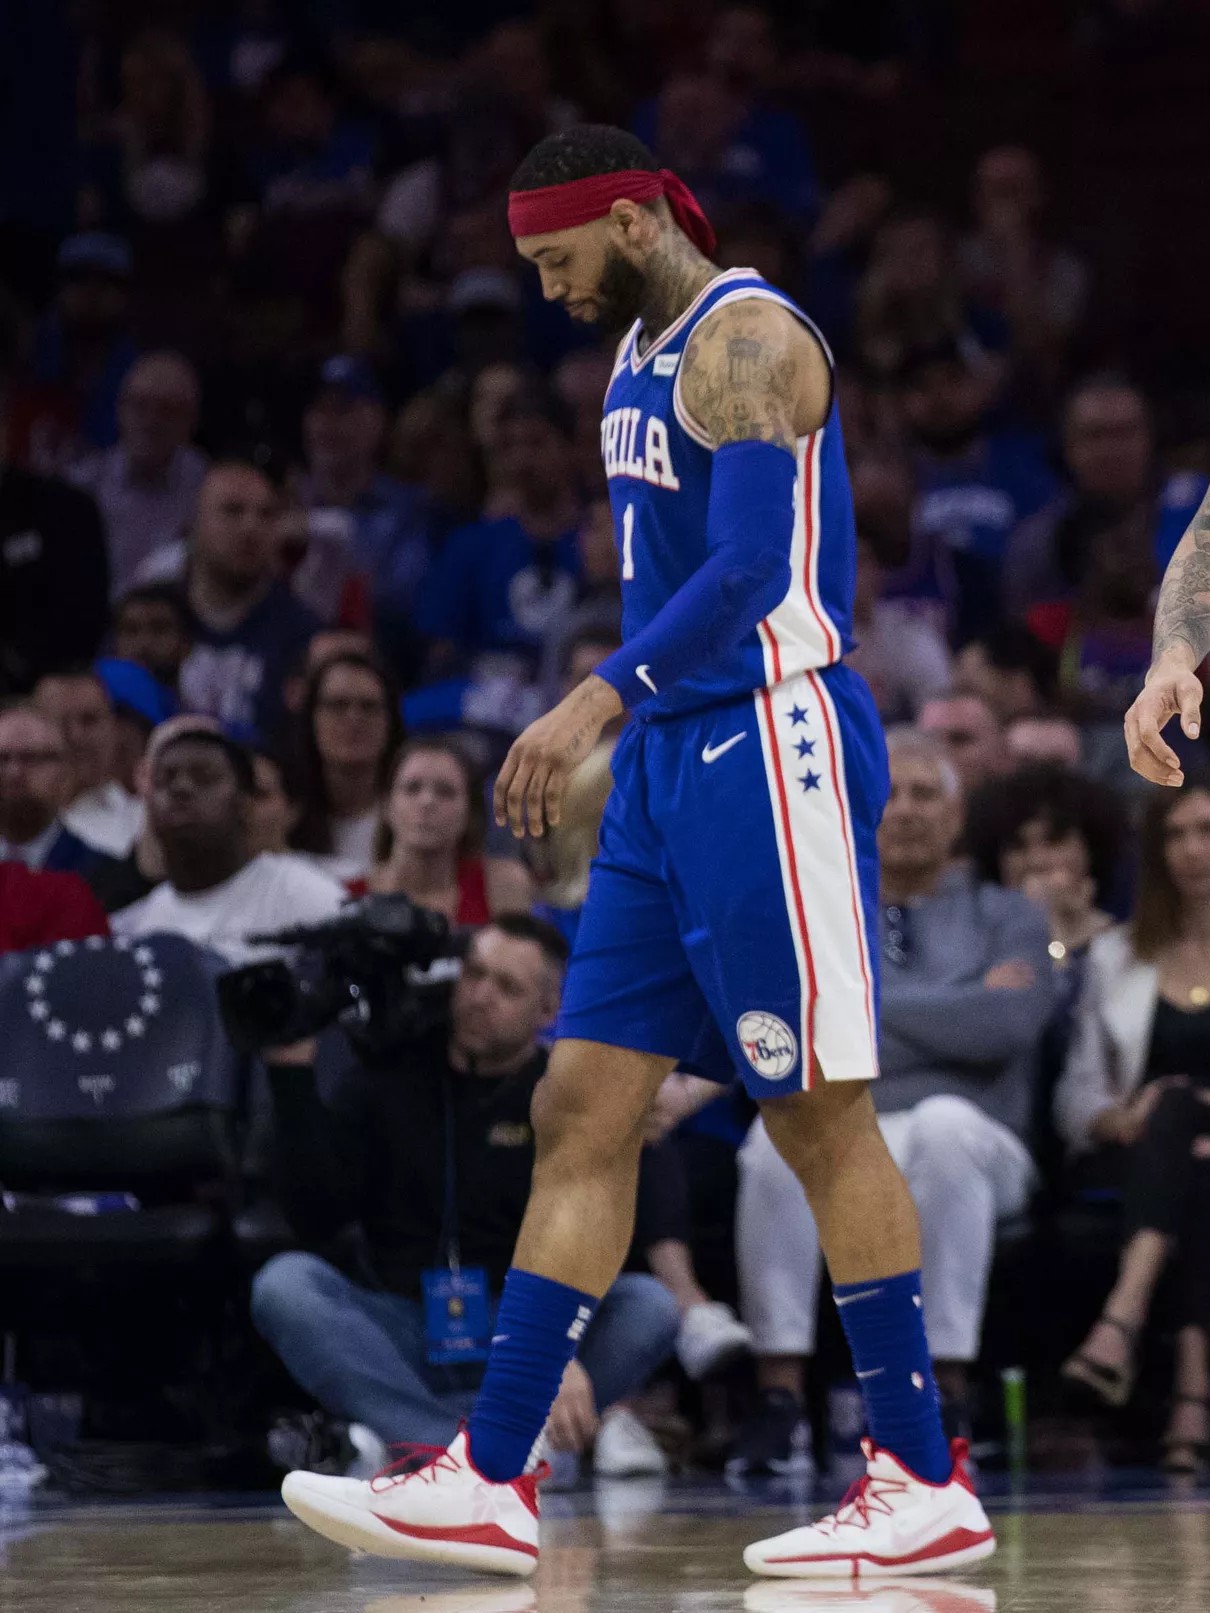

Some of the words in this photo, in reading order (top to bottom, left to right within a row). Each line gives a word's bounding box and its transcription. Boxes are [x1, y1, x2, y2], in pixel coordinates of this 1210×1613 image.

[601, 406, 680, 491] HILA
[622, 502, 635, 581] 1
[742, 1038, 792, 1063] 76ers
